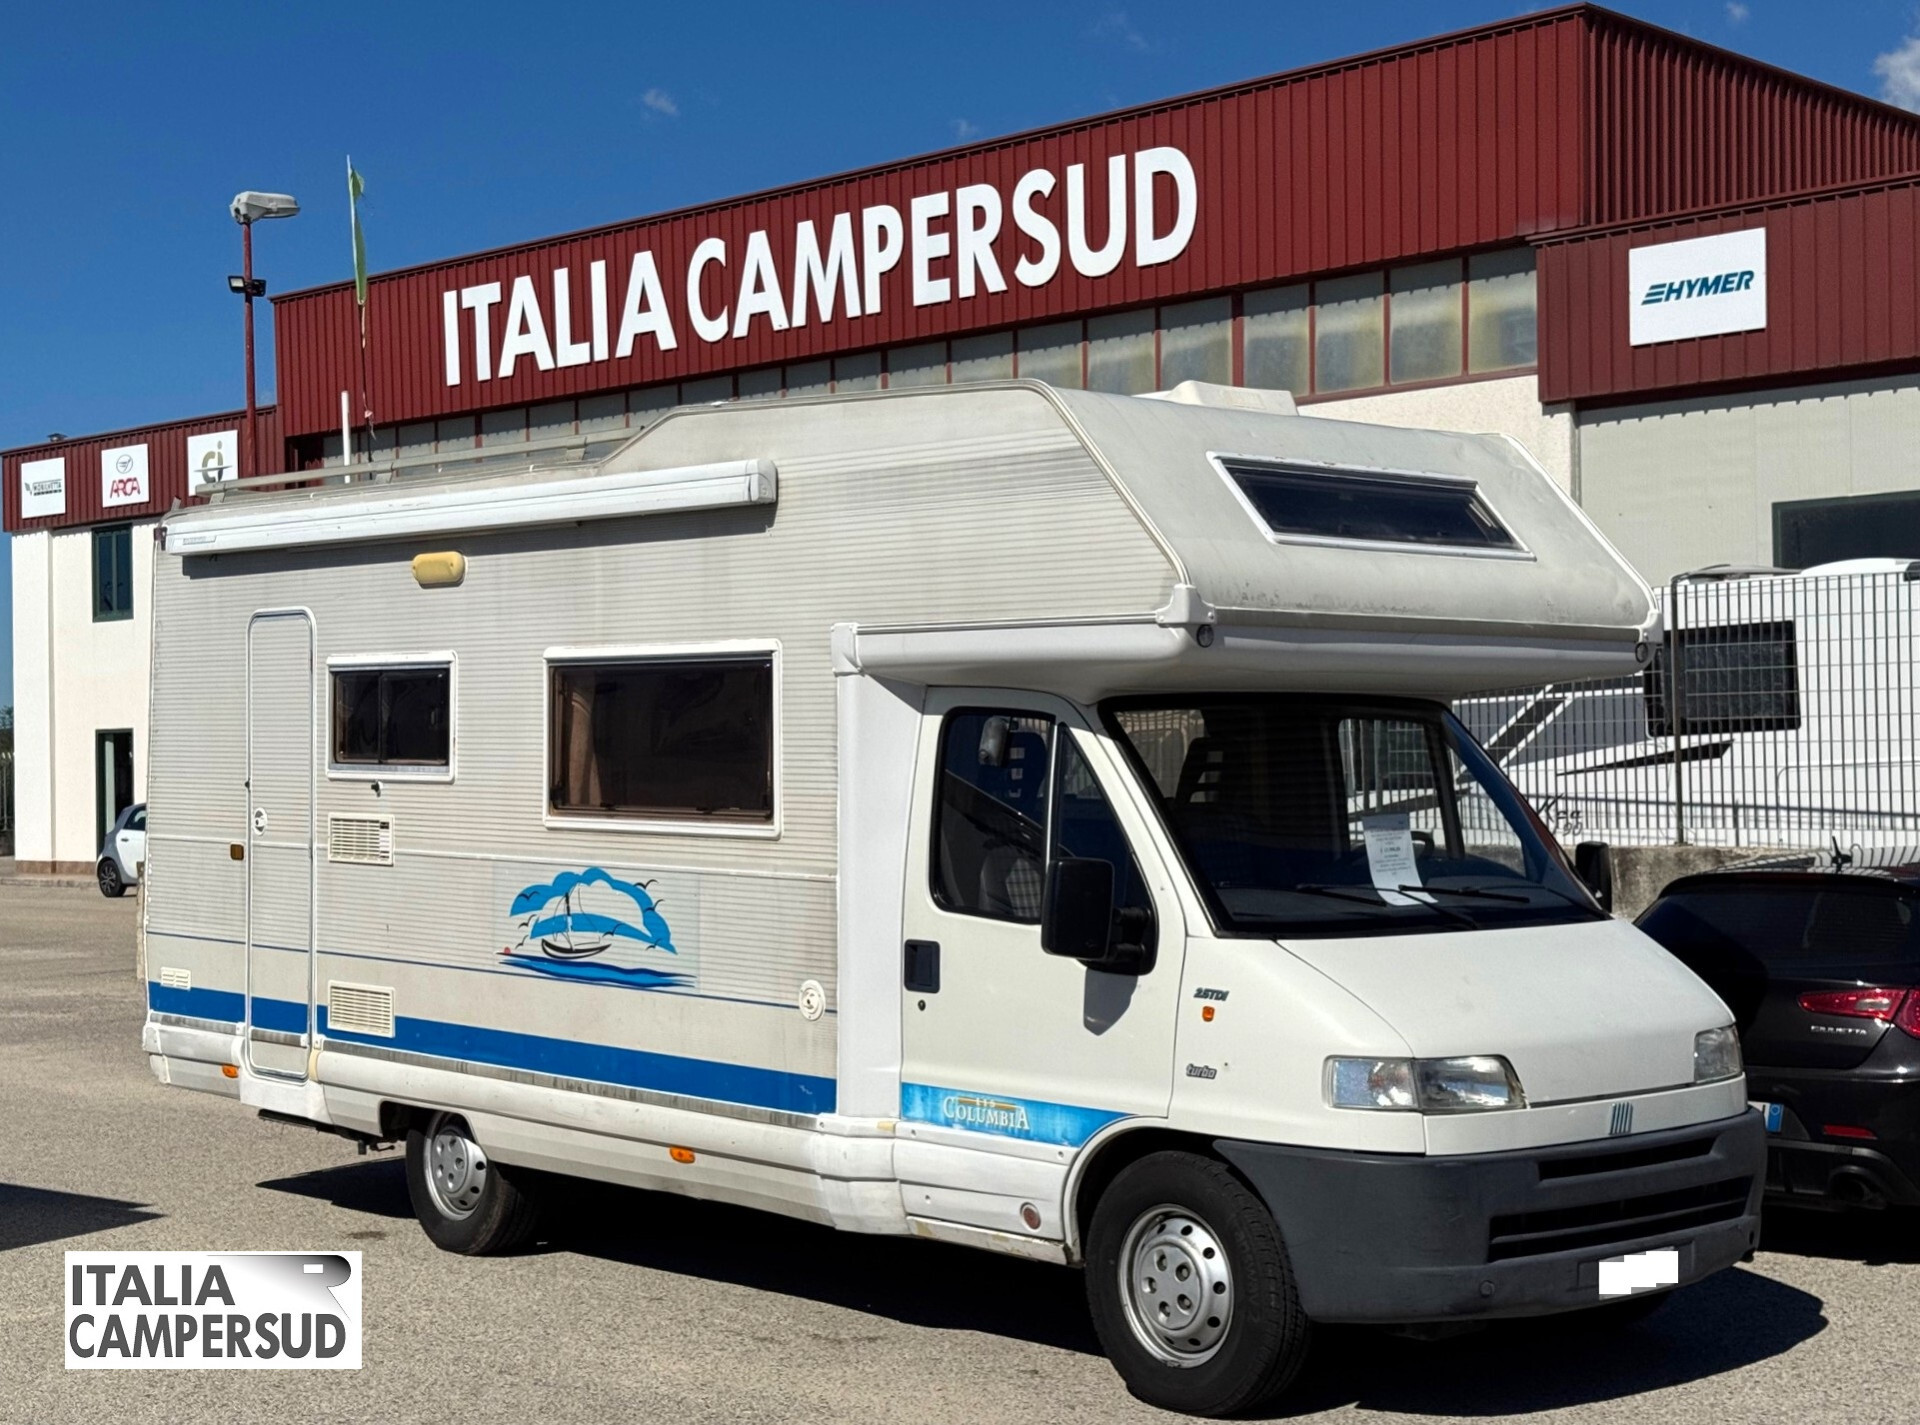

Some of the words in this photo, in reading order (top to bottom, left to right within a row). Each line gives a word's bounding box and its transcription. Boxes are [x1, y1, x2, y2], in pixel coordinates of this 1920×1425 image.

[443, 250, 678, 386] ITALIA
[687, 146, 1198, 342] CAMPERSUD
[1641, 270, 1755, 305] HYMER
[110, 477, 141, 499] ARCA
[1186, 1063, 1217, 1079] turbo
